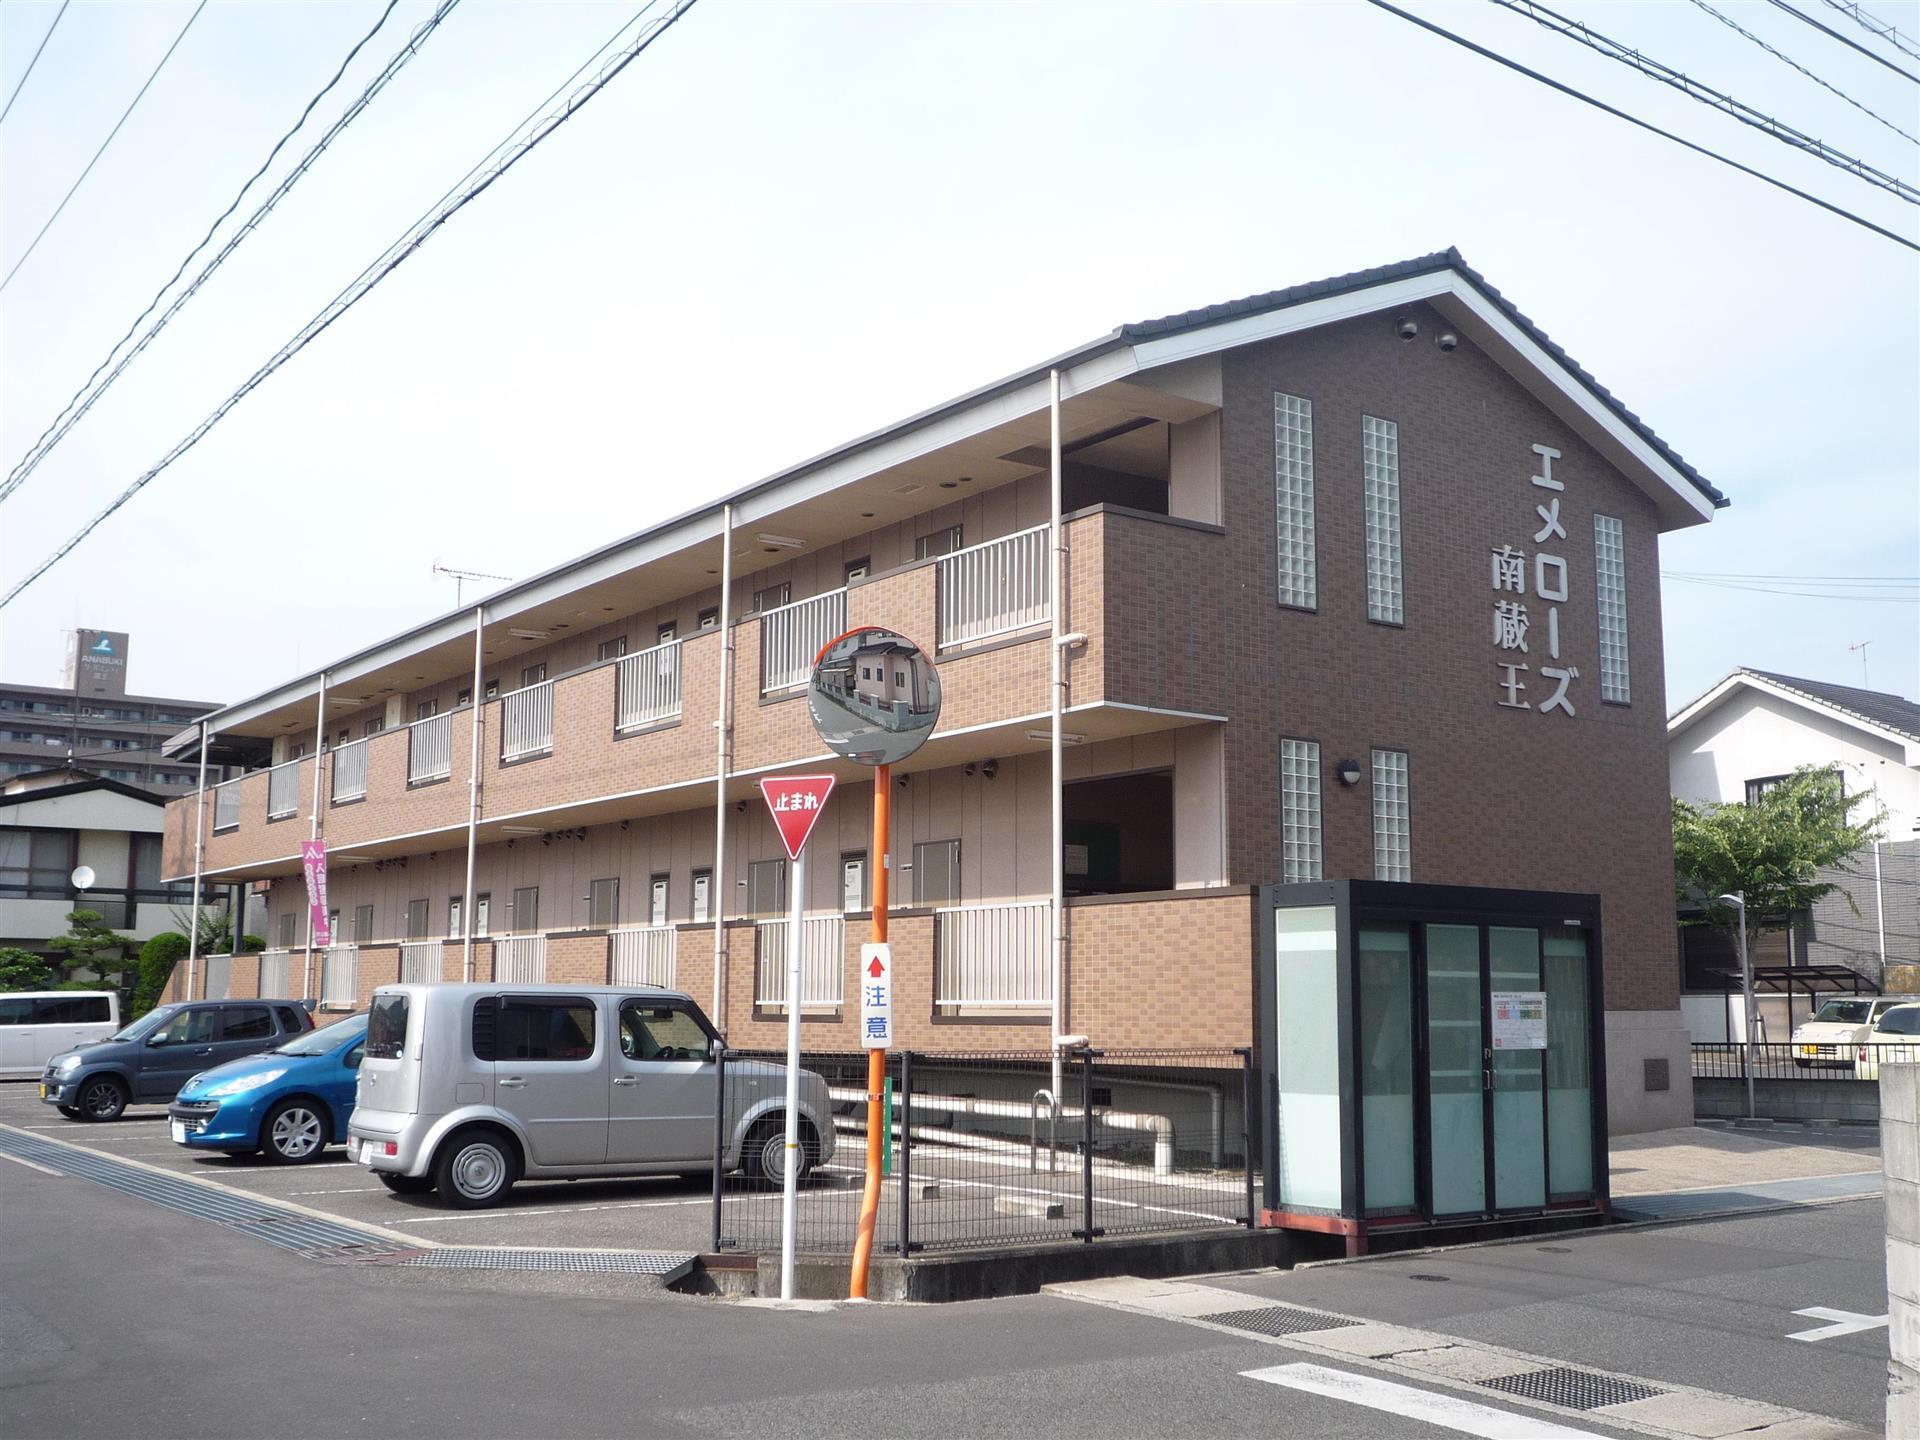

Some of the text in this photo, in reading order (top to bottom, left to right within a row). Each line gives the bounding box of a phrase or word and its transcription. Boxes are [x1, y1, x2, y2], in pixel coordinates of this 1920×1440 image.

[1531, 443, 1579, 717] エメローズ
[1491, 545, 1531, 709] 南蔵王
[82, 656, 123, 666] ANABUKI
[774, 792, 819, 811] 止まれ
[866, 985, 887, 1038] 注意
